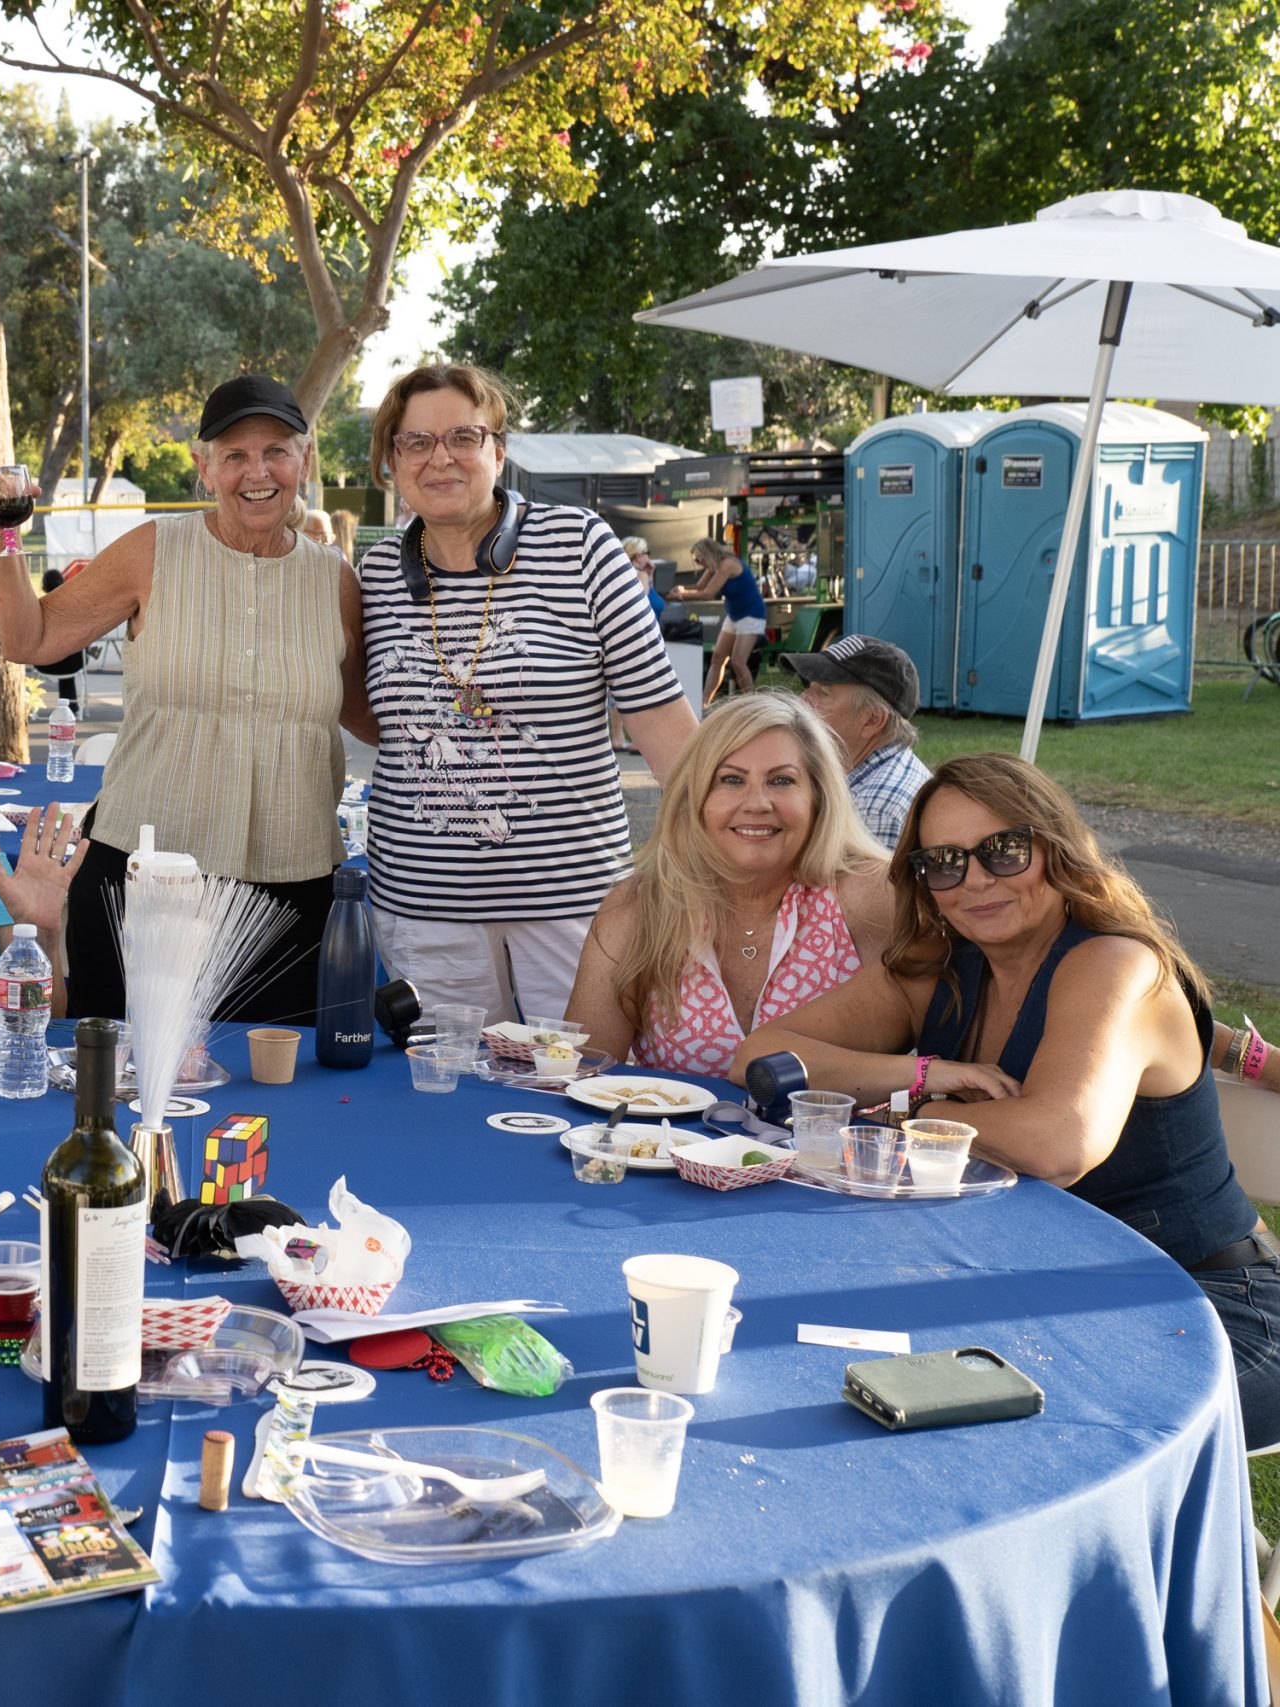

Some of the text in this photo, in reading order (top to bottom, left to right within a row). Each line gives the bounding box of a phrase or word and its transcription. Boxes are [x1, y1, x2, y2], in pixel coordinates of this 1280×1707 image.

[335, 1032, 372, 1043] Farther
[1249, 1055, 1261, 1069] 21
[42, 1537, 119, 1560] BINGO
